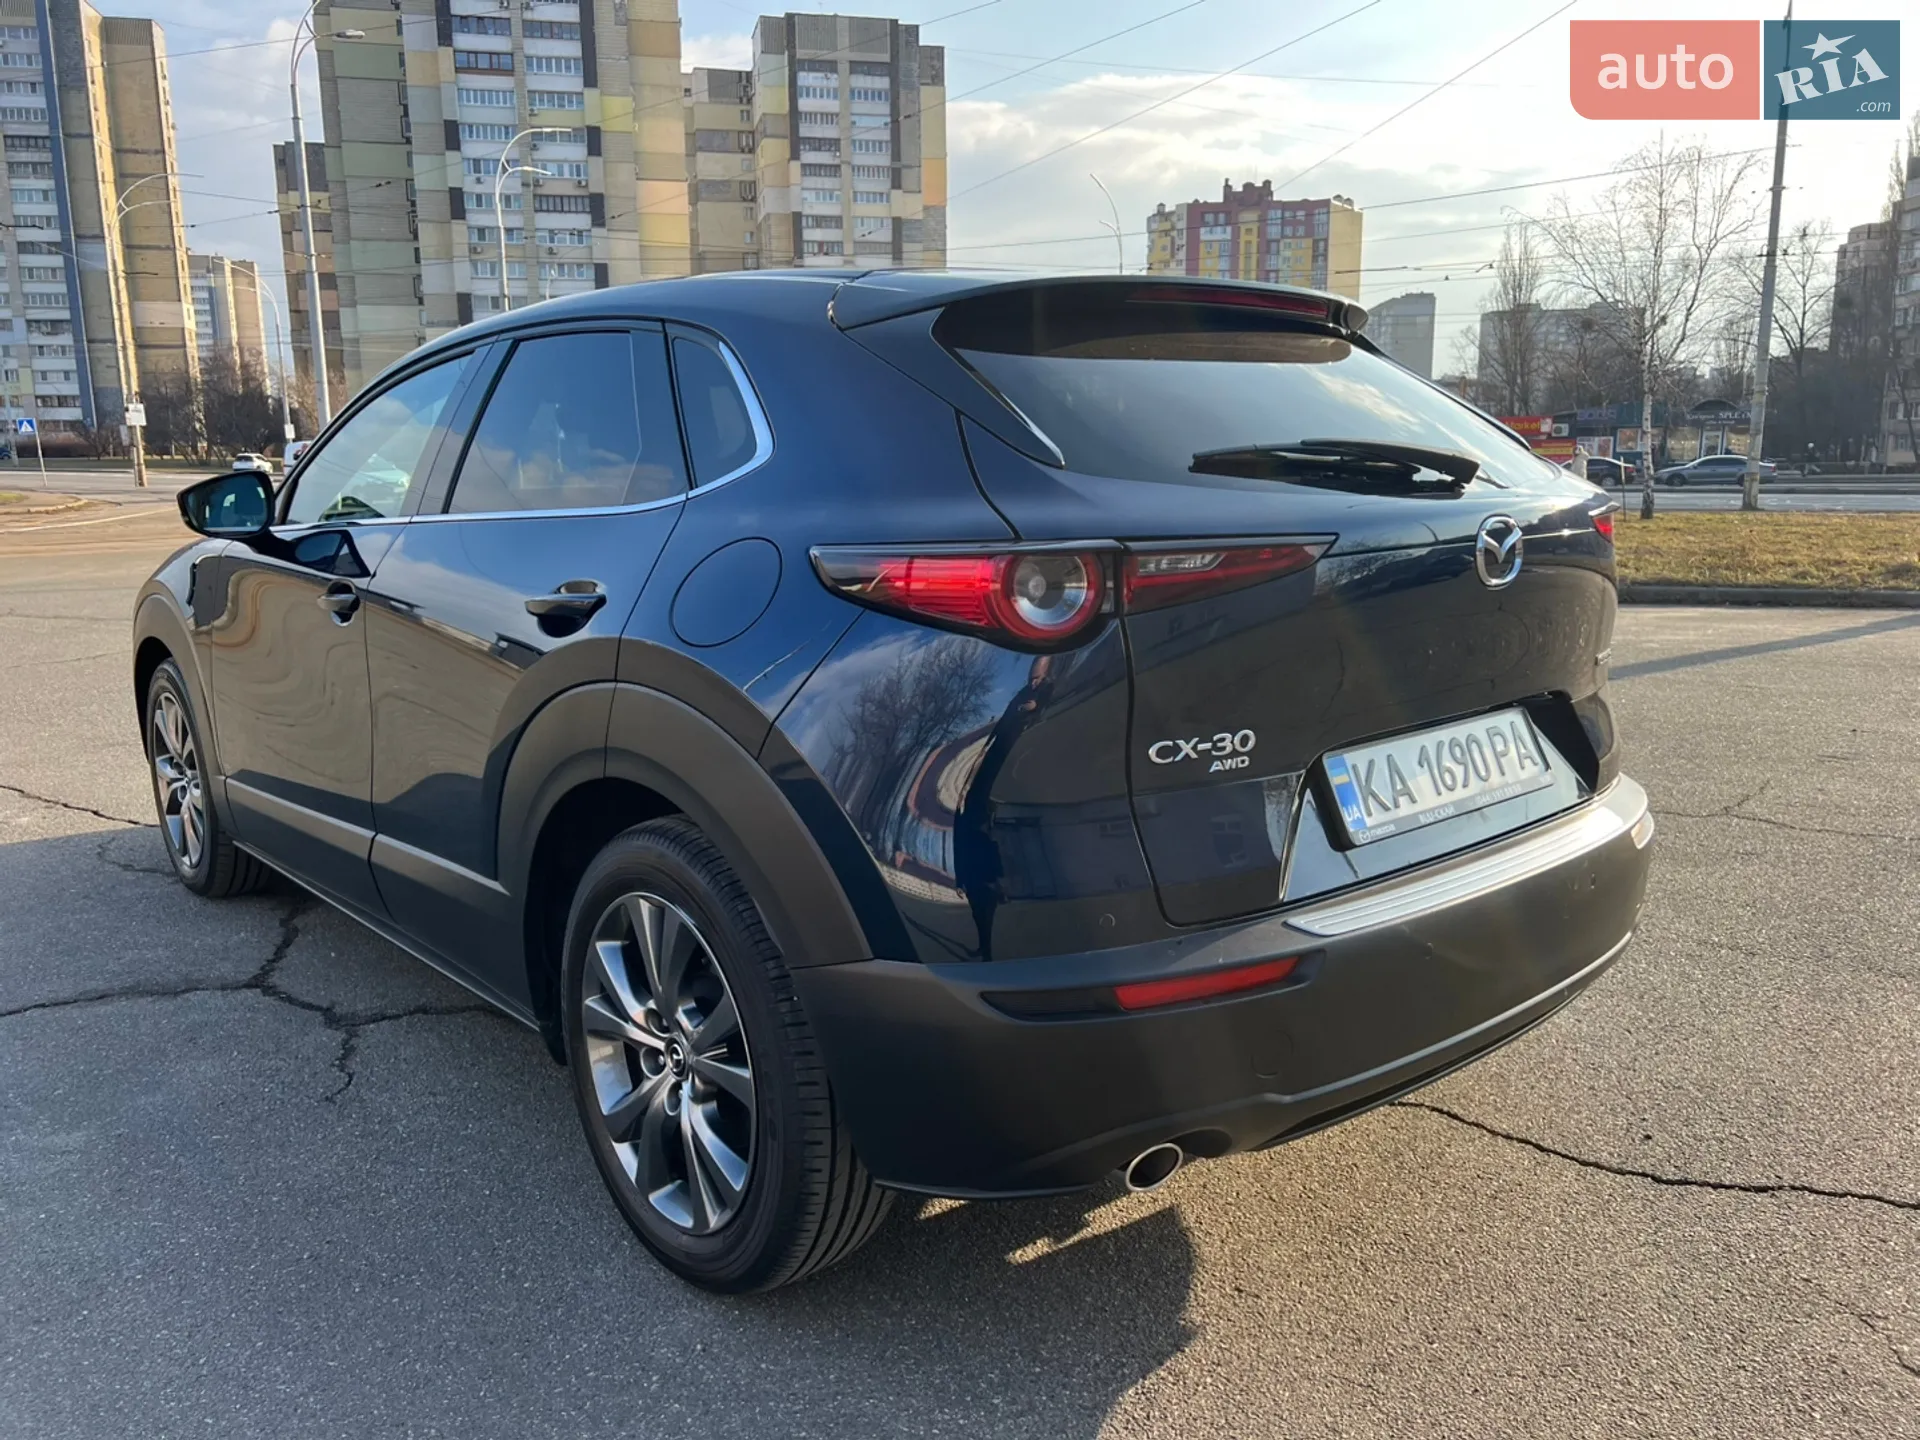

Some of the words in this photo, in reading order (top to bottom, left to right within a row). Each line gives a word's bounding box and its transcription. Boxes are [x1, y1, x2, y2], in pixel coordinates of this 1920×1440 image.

[1148, 729, 1256, 764] CX-30
[1209, 756, 1250, 773] AWD
[1352, 753, 1417, 817] KA
[1418, 733, 1491, 796] 1690
[1486, 720, 1539, 777] PA
[1343, 804, 1361, 820] UA
